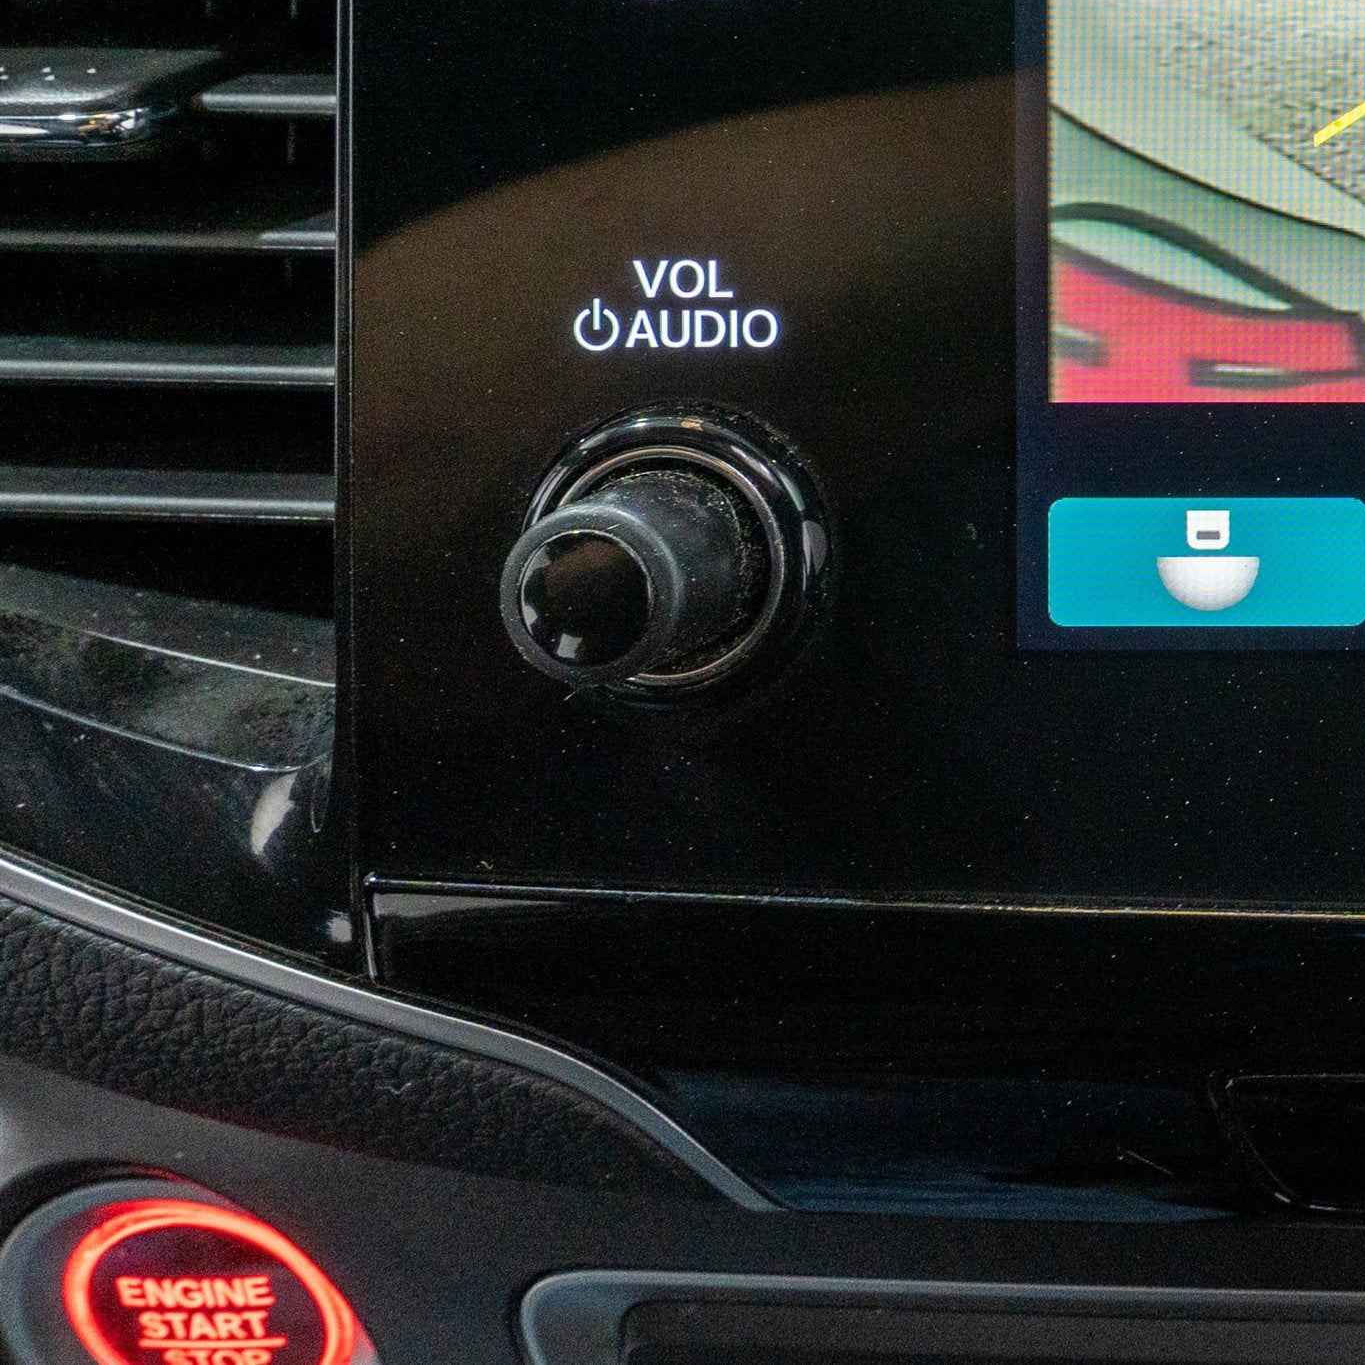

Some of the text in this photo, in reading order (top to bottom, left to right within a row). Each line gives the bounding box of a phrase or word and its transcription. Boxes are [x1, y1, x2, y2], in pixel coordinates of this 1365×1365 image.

[632, 259, 734, 298] VOL
[625, 309, 778, 348] AUDIO
[115, 1275, 277, 1307] ENGINE
[138, 1311, 268, 1340] START
